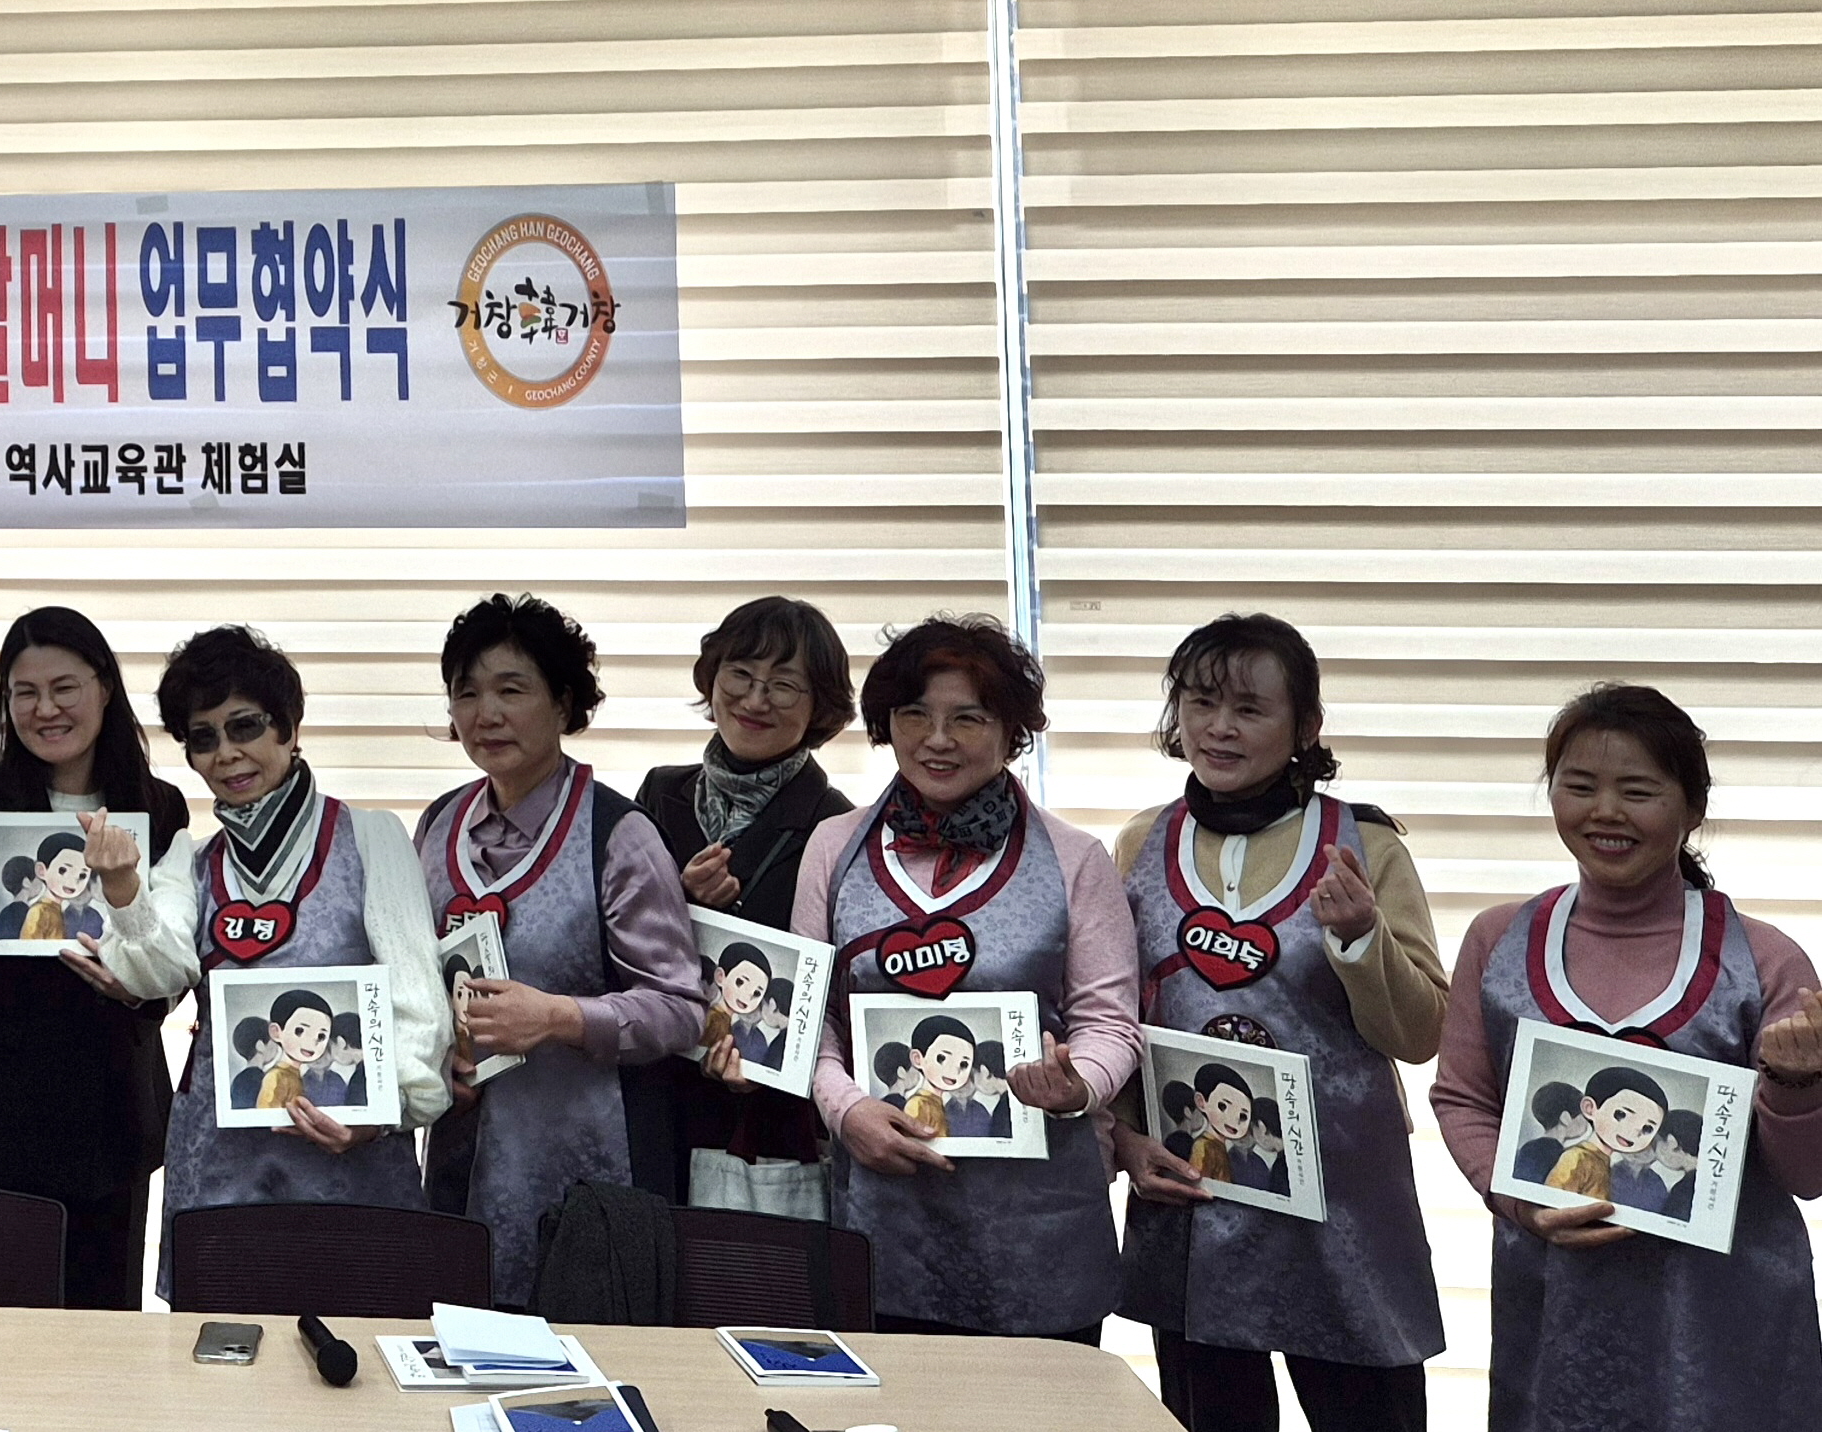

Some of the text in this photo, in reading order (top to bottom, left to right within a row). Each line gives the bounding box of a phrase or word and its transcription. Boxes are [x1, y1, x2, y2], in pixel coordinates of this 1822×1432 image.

[467, 221, 600, 283] GEOCHANG HAN GEOCHANG
[139, 218, 409, 402] 업무협약식
[525, 338, 601, 401] GEOCHANG COUNTY
[5, 443, 187, 496] 역사교육관
[201, 441, 307, 495] 체험실
[223, 917, 245, 939] 김
[1185, 926, 1264, 970] 이희숙
[1707, 1143, 1727, 1178] 시간
